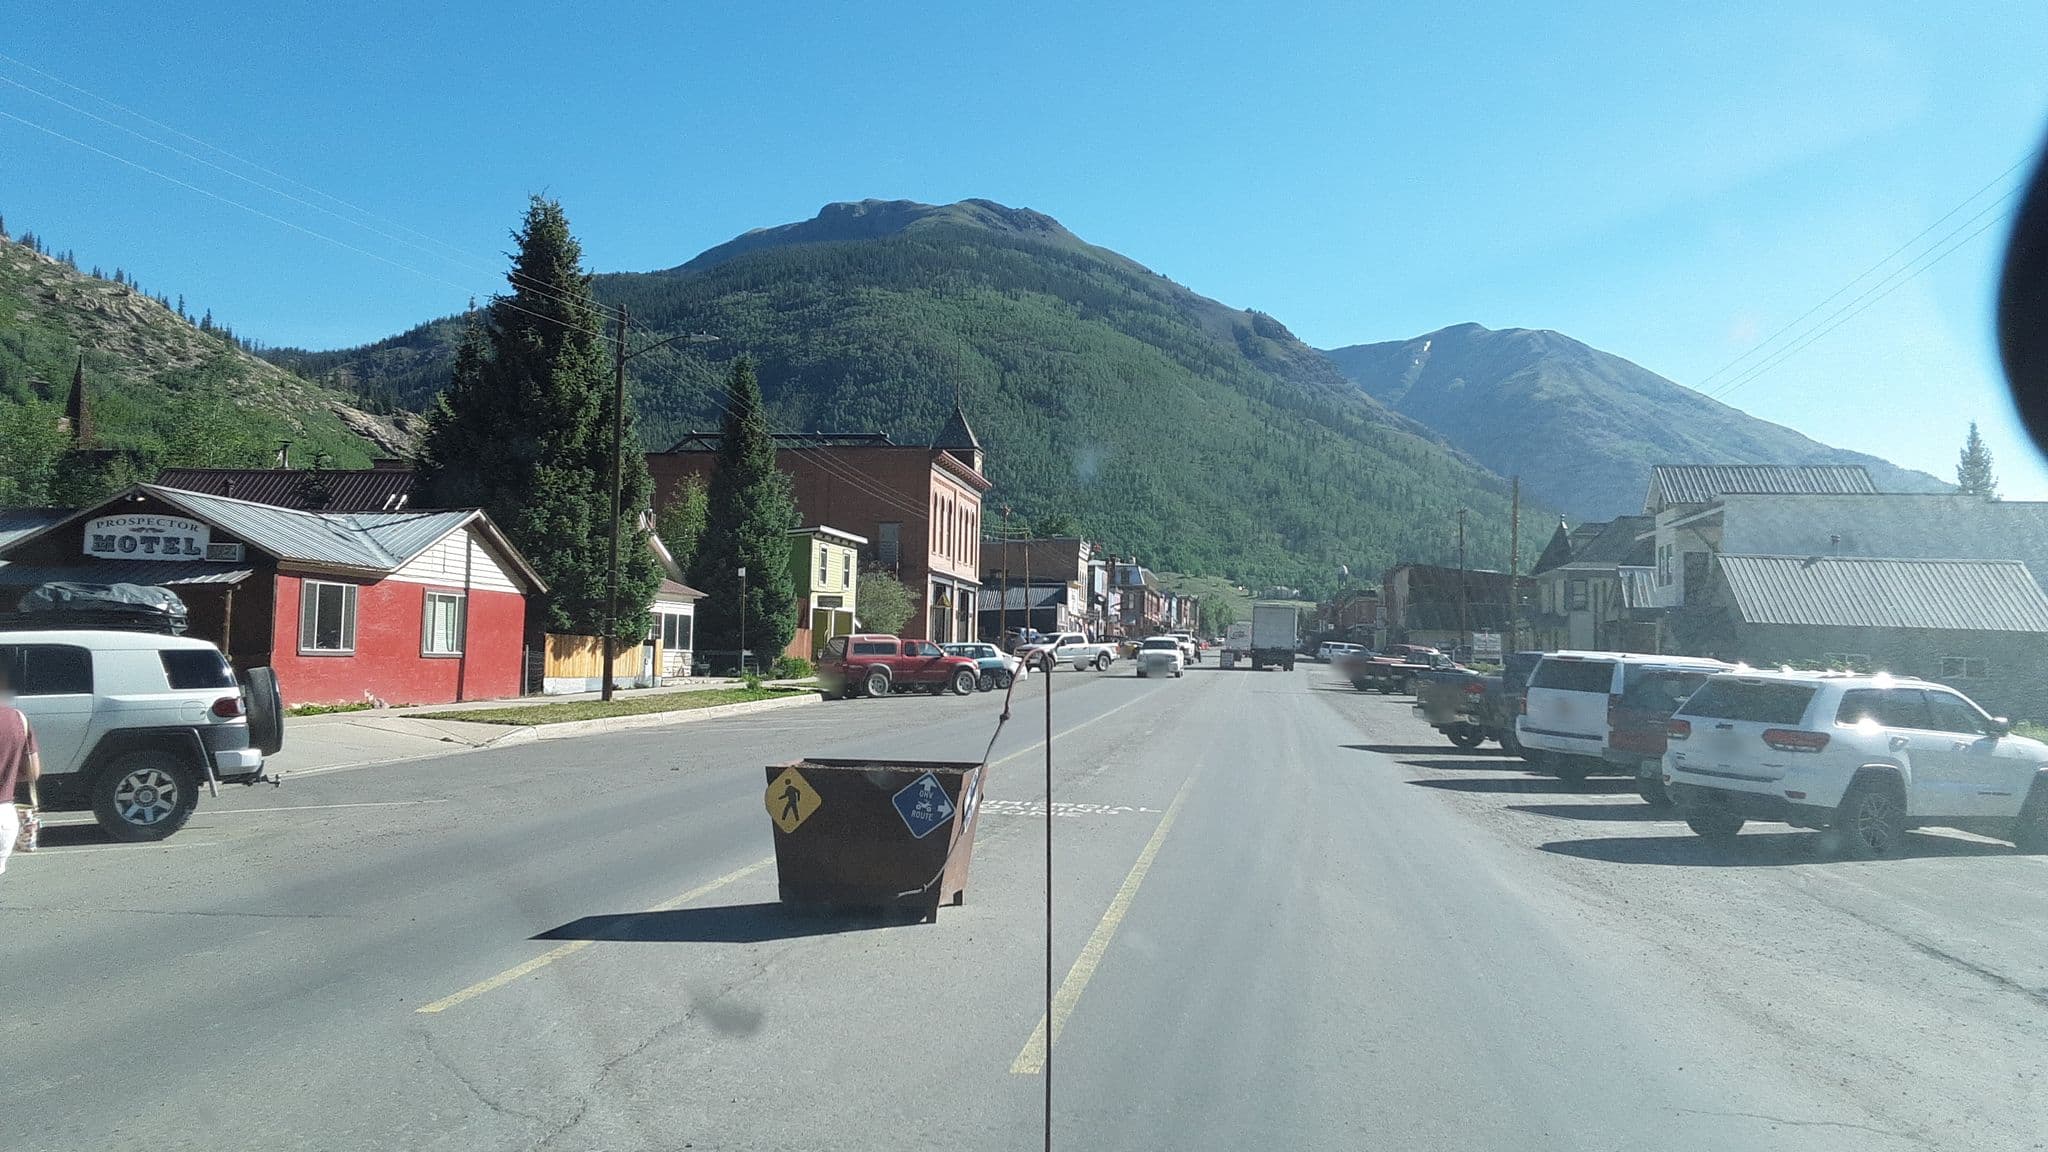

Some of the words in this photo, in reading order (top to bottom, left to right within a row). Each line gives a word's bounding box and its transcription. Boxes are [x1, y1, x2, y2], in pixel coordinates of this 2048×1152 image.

[96, 517, 199, 532] PROSPECTOR
[92, 534, 201, 555] MOTEL
[919, 790, 934, 799] OHV
[911, 810, 934, 821] ROUTE
